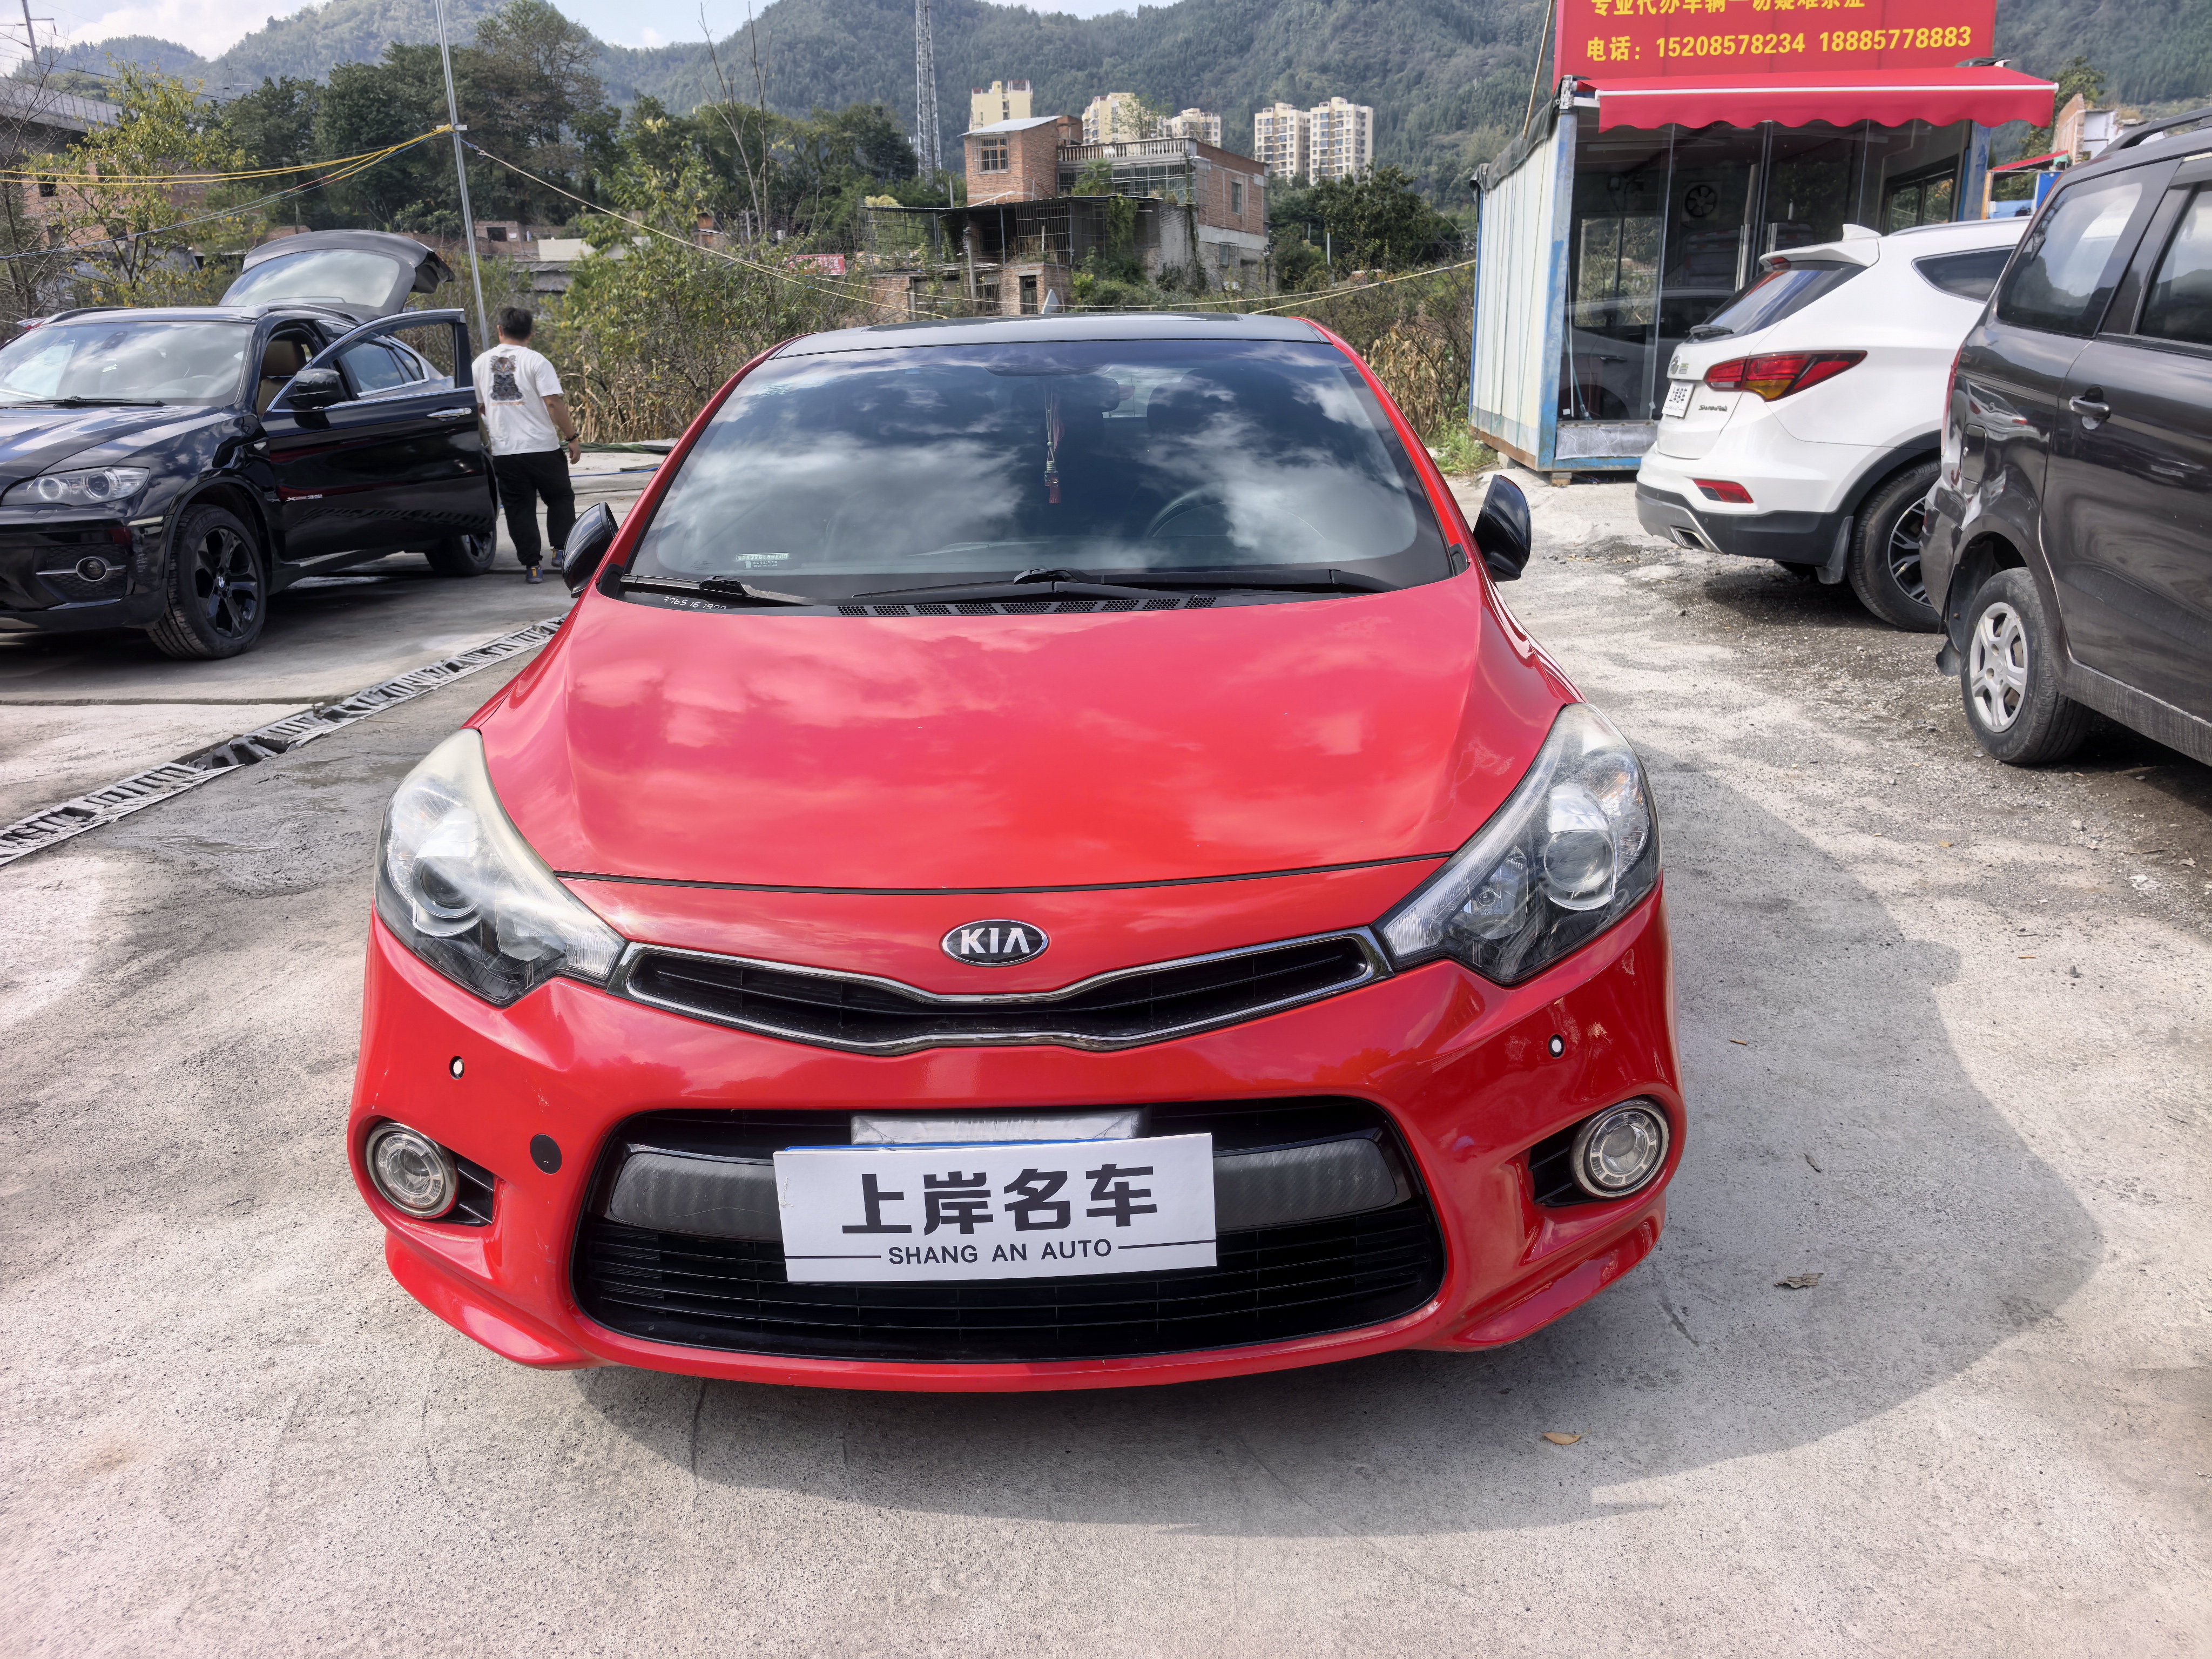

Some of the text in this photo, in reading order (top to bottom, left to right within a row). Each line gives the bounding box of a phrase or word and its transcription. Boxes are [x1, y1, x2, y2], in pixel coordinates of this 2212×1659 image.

[1656, 33, 1805, 57] 15208578234
[1819, 26, 1971, 52] 18885778883
[960, 927, 1030, 955] KIA
[841, 1163, 1158, 1236] 上岸名车
[888, 1238, 1112, 1265] SHANG AN AUTO
